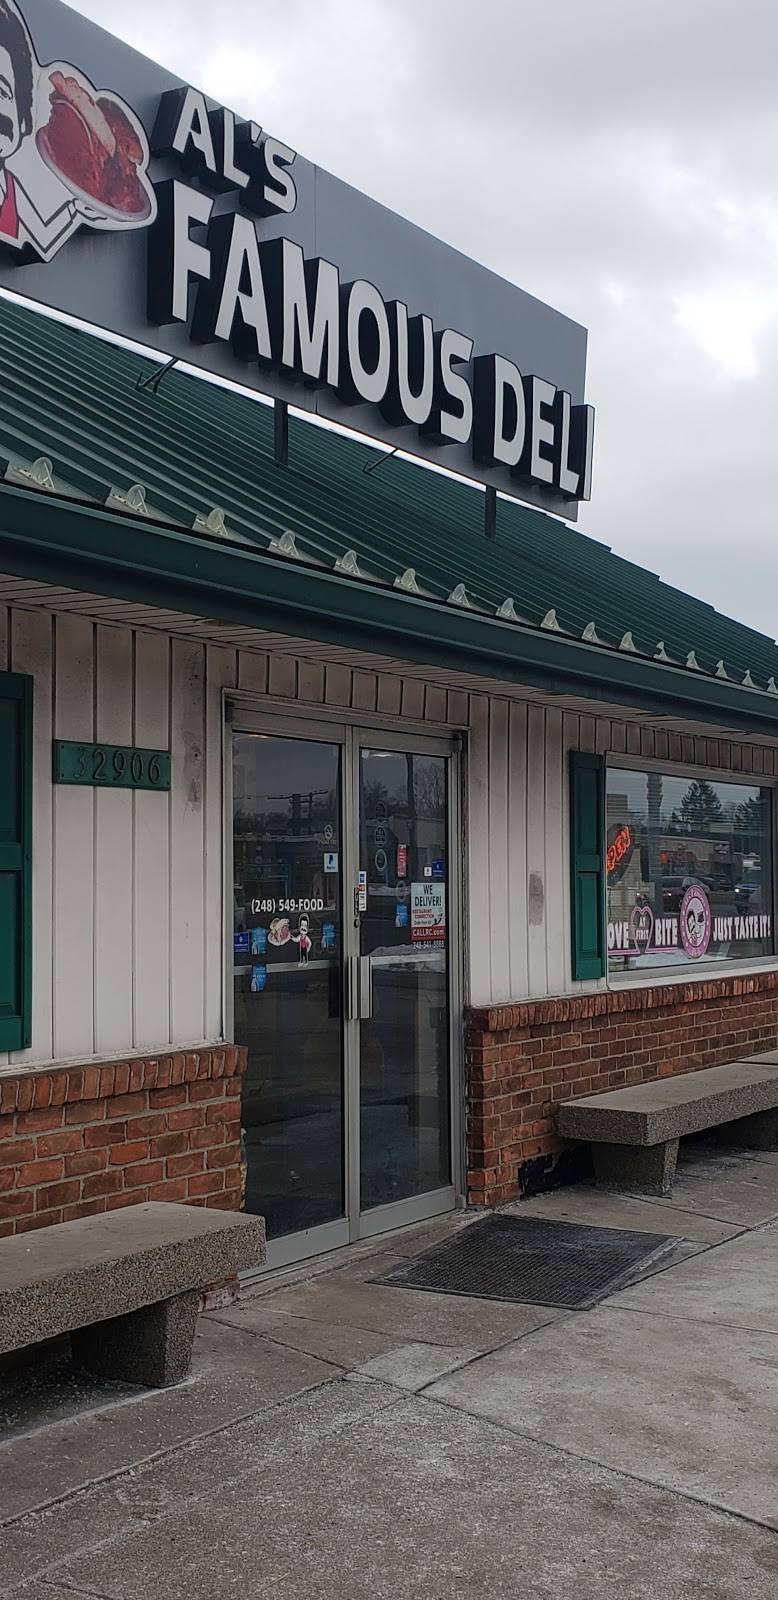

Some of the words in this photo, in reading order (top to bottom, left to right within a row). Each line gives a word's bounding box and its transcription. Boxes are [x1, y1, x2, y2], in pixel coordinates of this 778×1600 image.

[168, 87, 297, 214] AL'S
[169, 178, 475, 445] FAMOUS
[490, 353, 595, 501] DELI
[73, 747, 161, 785] 32906
[414, 896, 442, 907] DELIVER!
[423, 884, 433, 895] WE
[251, 898, 276, 915] (248)
[278, 898, 324, 912] 549-FOOD
[412, 928, 445, 937] CALLRC.com
[607, 921, 629, 949] OVE
[635, 929, 650, 940] FIRST
[654, 918, 678, 946] BITE
[713, 916, 733, 942] JUST
[735, 914, 759, 940] TASTE
[759, 915, 771, 938] IT!
